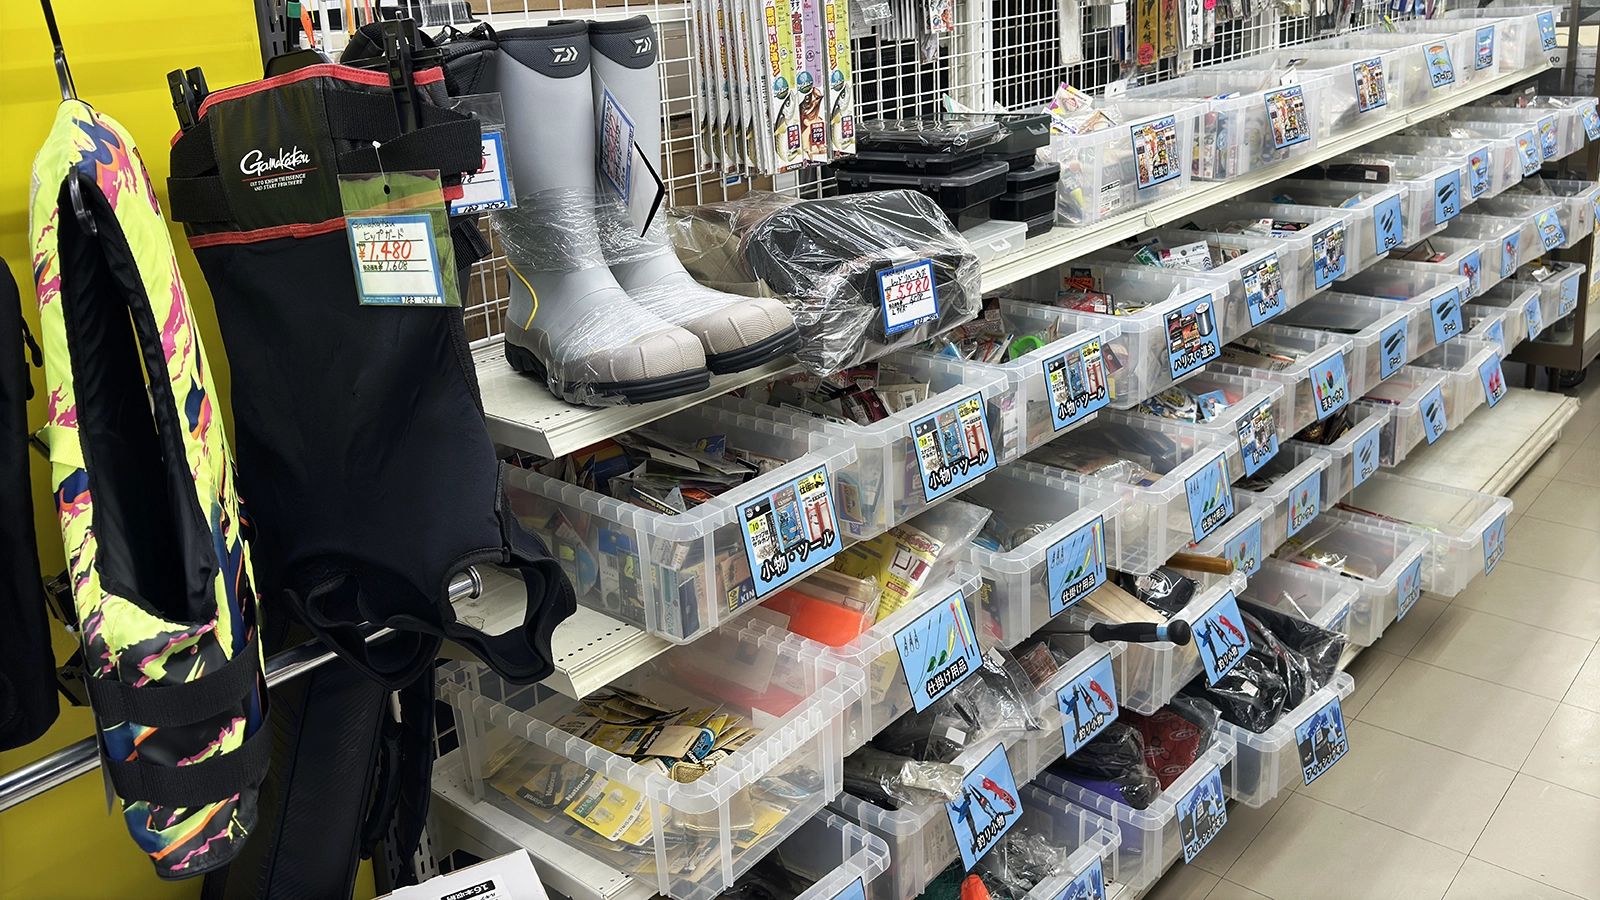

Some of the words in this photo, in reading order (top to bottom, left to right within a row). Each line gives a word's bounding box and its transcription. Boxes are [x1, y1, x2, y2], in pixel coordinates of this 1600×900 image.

[1284, 128, 1299, 142] 仕掛け
[240, 146, 310, 176] Gamakatsu
[1152, 163, 1168, 179] 仕掛け
[1443, 204, 1454, 216] ワーム
[364, 228, 404, 240] ヒップガード
[1384, 234, 1397, 249] ワーム
[359, 239, 412, 262] ¥1,480
[1322, 258, 1341, 278] 針・ハリ
[1258, 292, 1280, 316] 針・ハリ
[1444, 322, 1456, 334] ワーム
[1173, 344, 1216, 371] ハリス・道糸
[1389, 354, 1402, 369] ワーム
[1057, 386, 1105, 421] 小物・ツール
[1321, 388, 1345, 412] 浮き・ウキ
[1433, 423, 1444, 435] ワーム
[1252, 439, 1272, 465] 針・ハリ
[929, 449, 988, 490] 小物・ツール
[1361, 465, 1373, 479] ワーム
[1202, 504, 1226, 533] 仕掛け用品
[1292, 505, 1314, 530] 浮き・ウキ
[752, 536, 770, 548] サルカン
[761, 530, 834, 582] 小物・ツール
[1061, 572, 1096, 605] 仕掛け用品
[1217, 644, 1239, 672] 釣り小物
[926, 656, 968, 699] 仕掛け用品
[1078, 715, 1104, 741] 釣り小物
[1305, 740, 1345, 780] フィッシングギア
[545, 772, 557, 797] National
[565, 774, 591, 801] National
[976, 812, 1006, 851] 釣り小物
[1187, 812, 1225, 859] フィッシングギア
